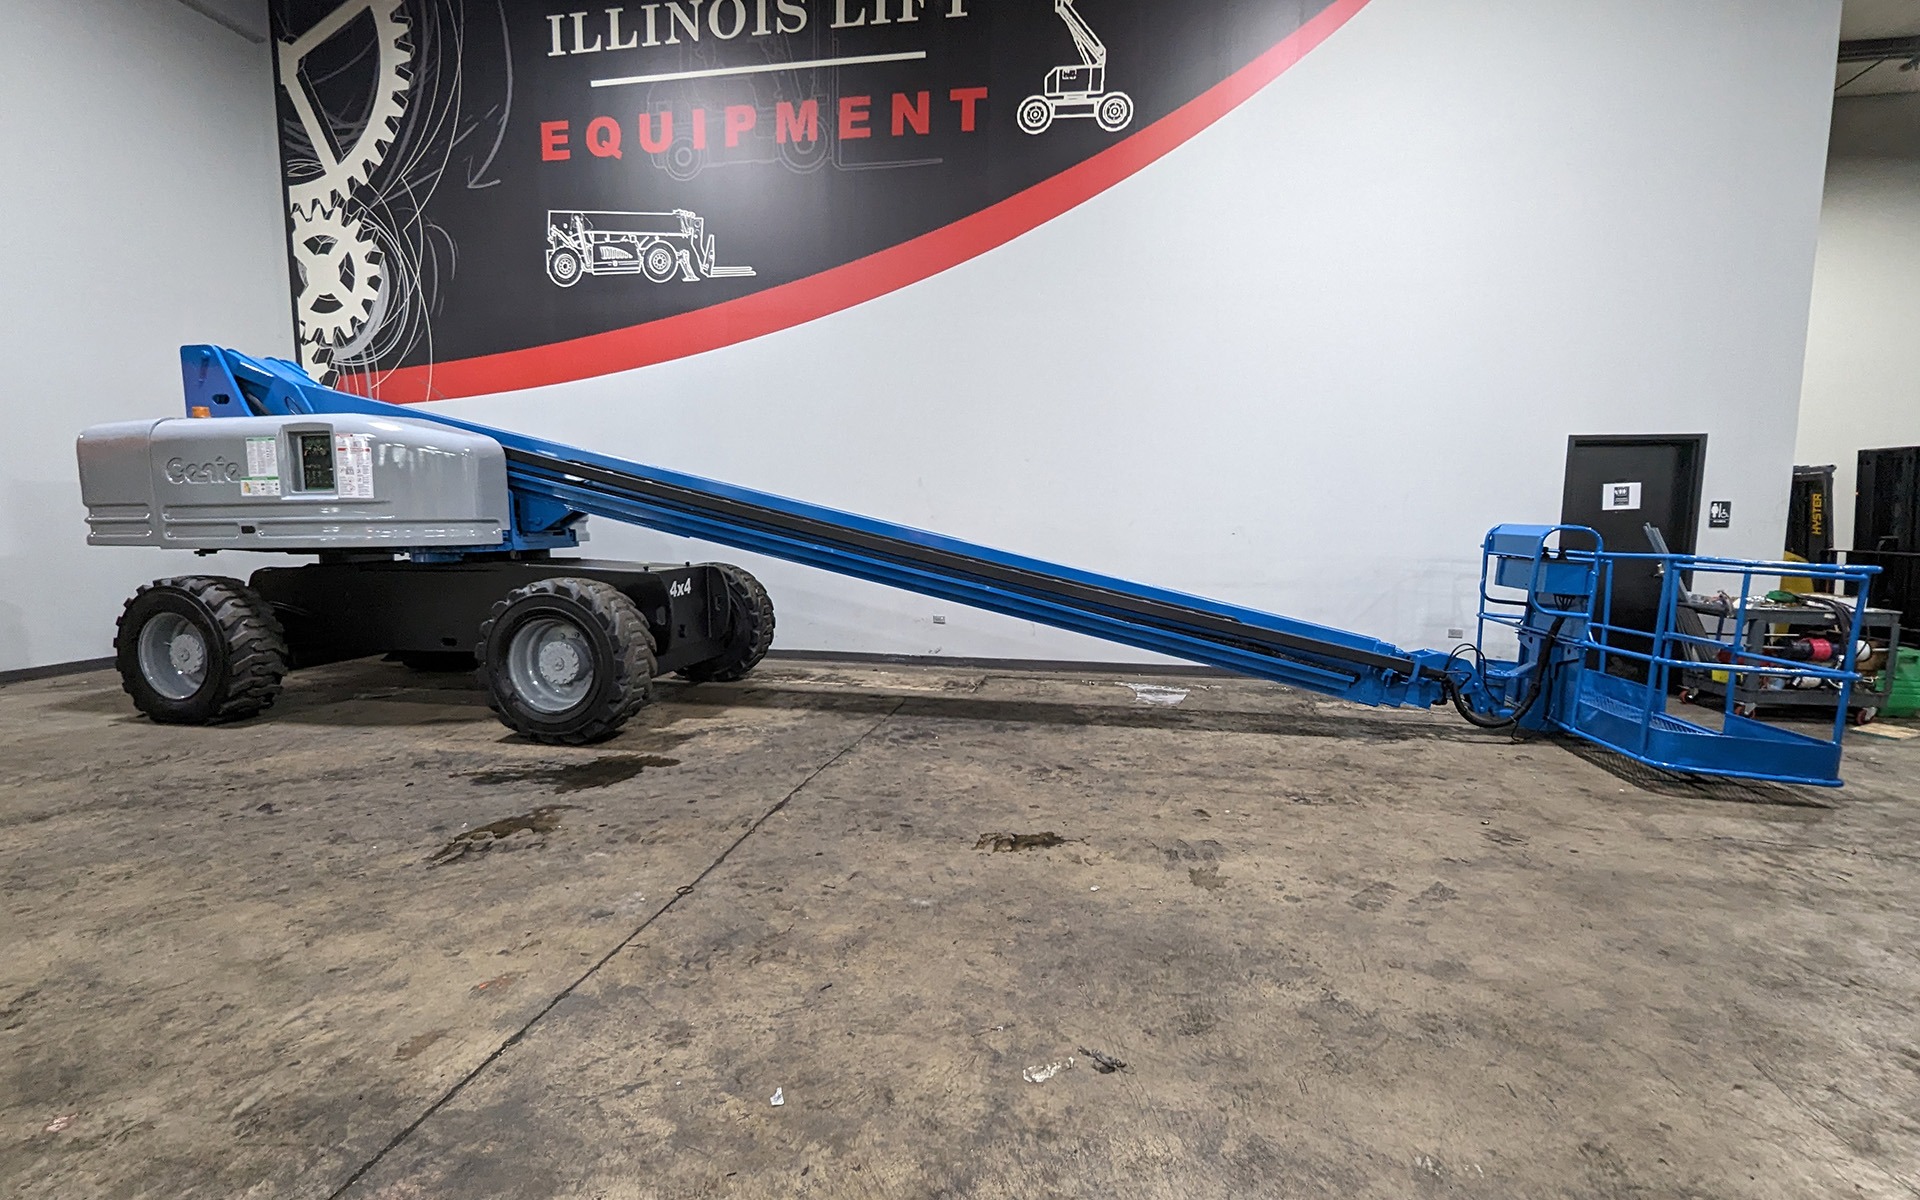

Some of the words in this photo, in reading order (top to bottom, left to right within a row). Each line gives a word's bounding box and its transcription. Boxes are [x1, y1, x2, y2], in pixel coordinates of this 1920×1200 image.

[546, 0, 807, 57] ILLINOIS
[541, 87, 988, 162] EQUIPMENT
[1811, 493, 1822, 535] HYSTER
[670, 577, 691, 597] 4x4
